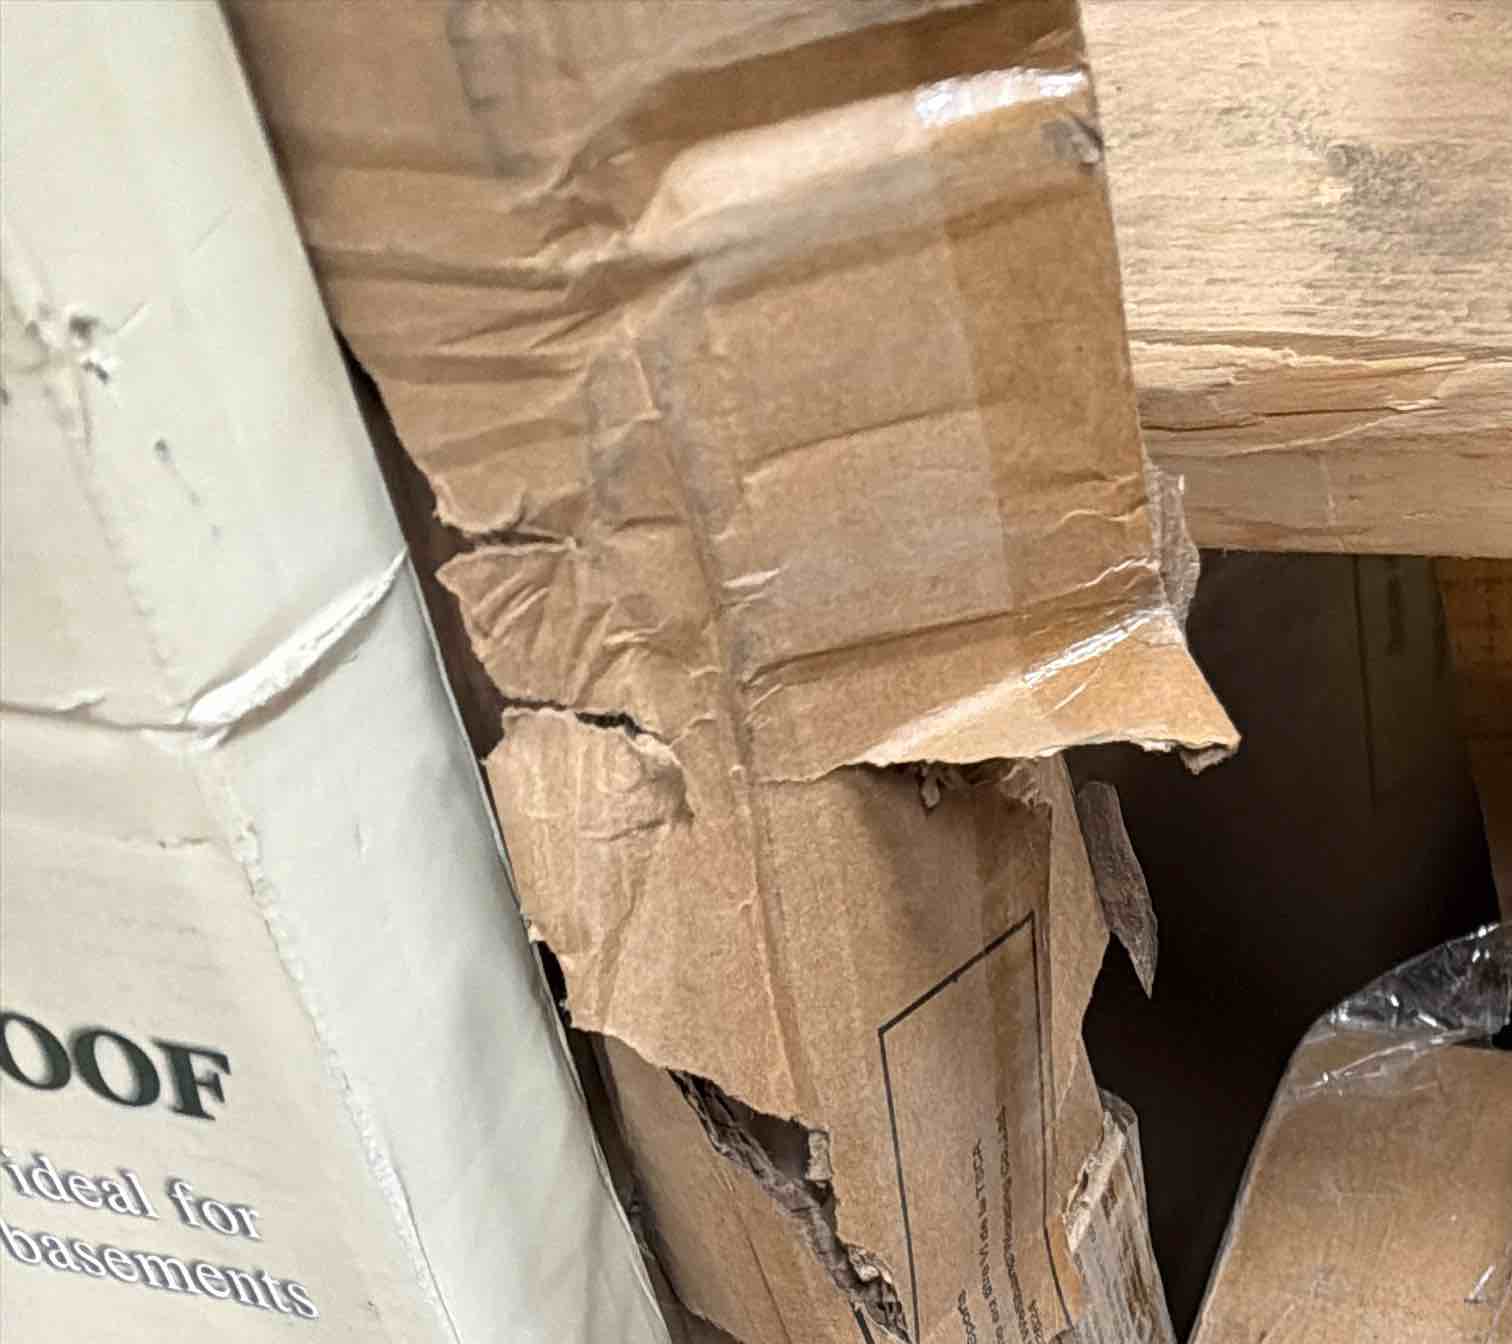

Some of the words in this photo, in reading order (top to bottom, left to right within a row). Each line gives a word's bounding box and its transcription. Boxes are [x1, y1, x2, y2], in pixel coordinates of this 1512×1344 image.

[1, 1149, 160, 1221] ideal
[167, 1178, 262, 1241] for
[0, 1217, 320, 1321] basements
